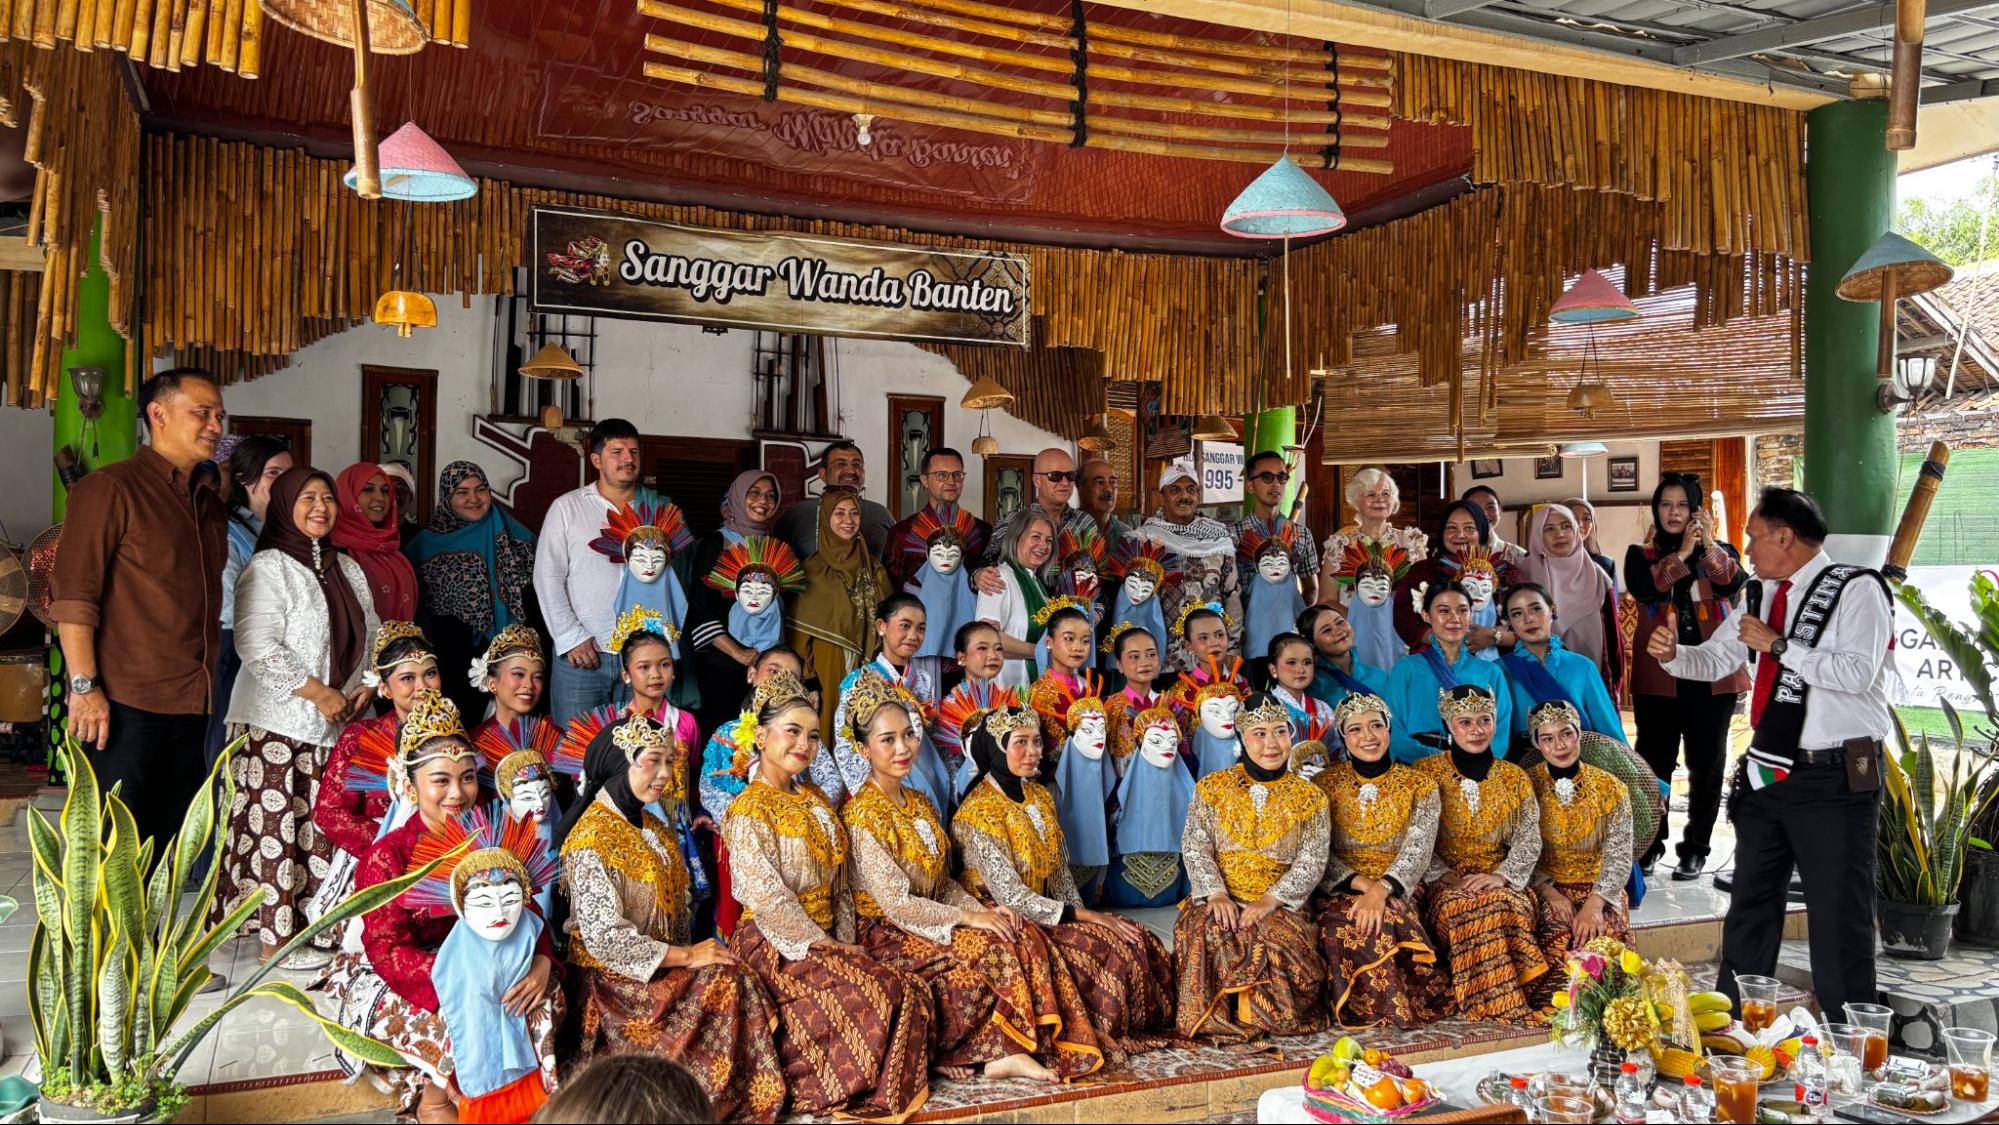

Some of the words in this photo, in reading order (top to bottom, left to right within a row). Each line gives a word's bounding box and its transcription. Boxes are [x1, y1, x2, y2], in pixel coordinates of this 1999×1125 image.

[619, 240, 773, 301] Sanggar
[779, 257, 904, 305] Wanda
[908, 269, 1014, 314] Banten
[1202, 451, 1234, 465] ANGGAR
